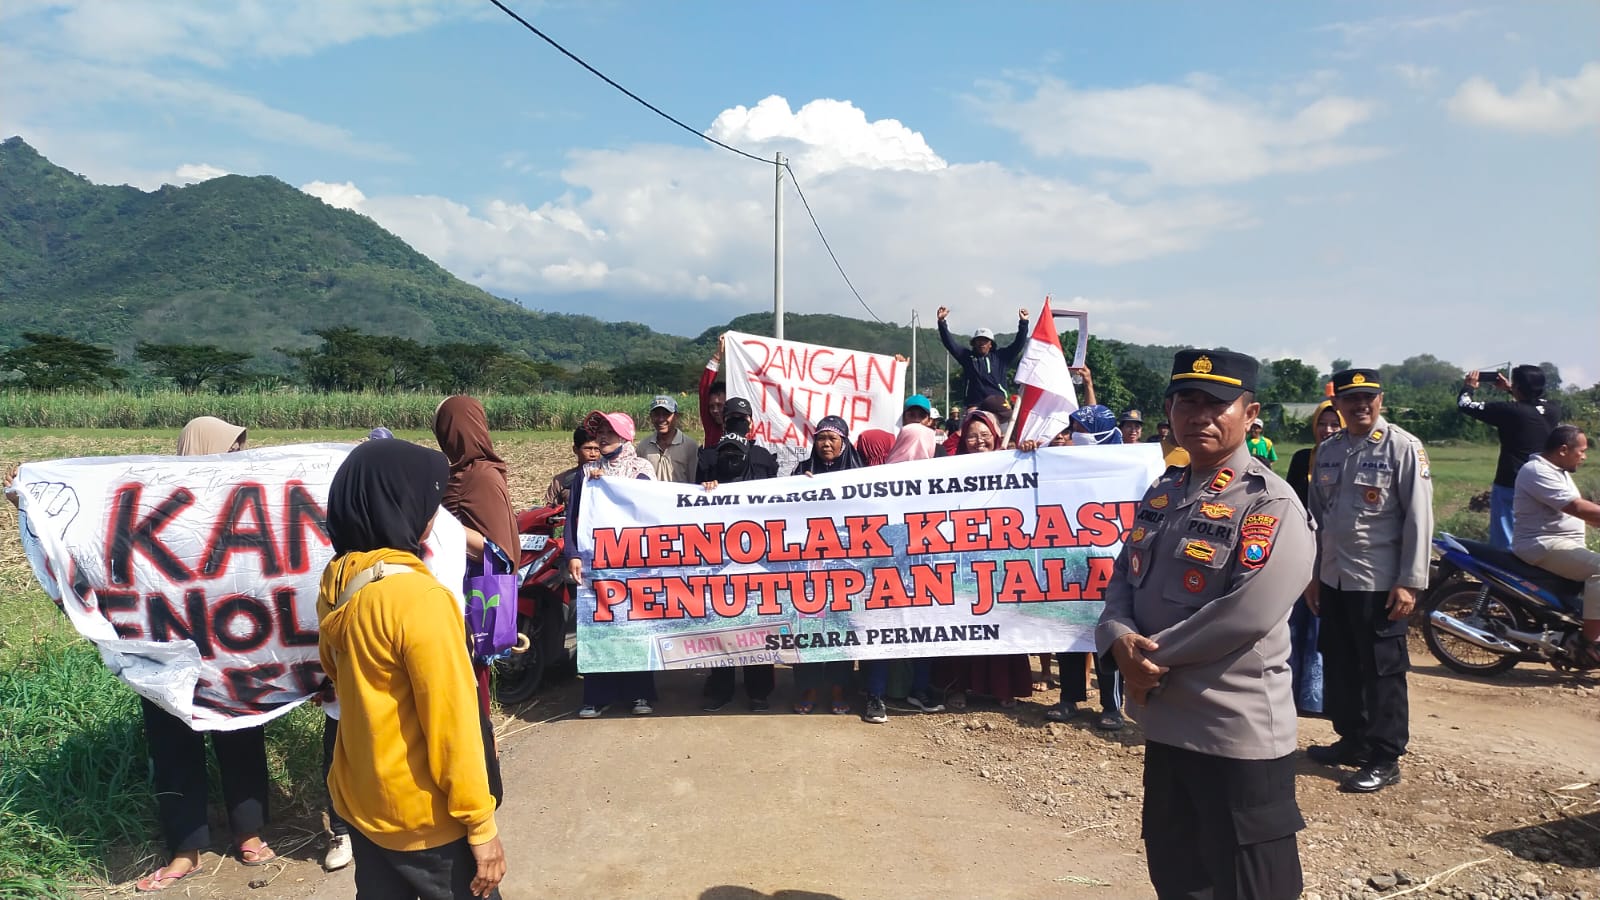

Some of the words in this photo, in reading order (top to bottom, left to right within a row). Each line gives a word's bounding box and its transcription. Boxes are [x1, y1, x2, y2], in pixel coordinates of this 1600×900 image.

[742, 340, 896, 394] JANGAN
[749, 377, 871, 431] TUTUP
[676, 493, 740, 507] KAMI
[747, 488, 836, 504] WARGA
[841, 480, 922, 500] DUSUN
[928, 472, 1039, 495] KASIHAN
[592, 514, 894, 570] MENOLAK
[904, 501, 1142, 555] KERAS!
[1188, 520, 1233, 540] POLRI
[592, 563, 956, 622] PENUTUPAN
[971, 556, 1115, 616] JALA
[683, 636, 724, 655] HATI
[765, 630, 861, 651] SECARA
[866, 624, 1000, 645] PERMANEN
[738, 651, 781, 665] MASUK
